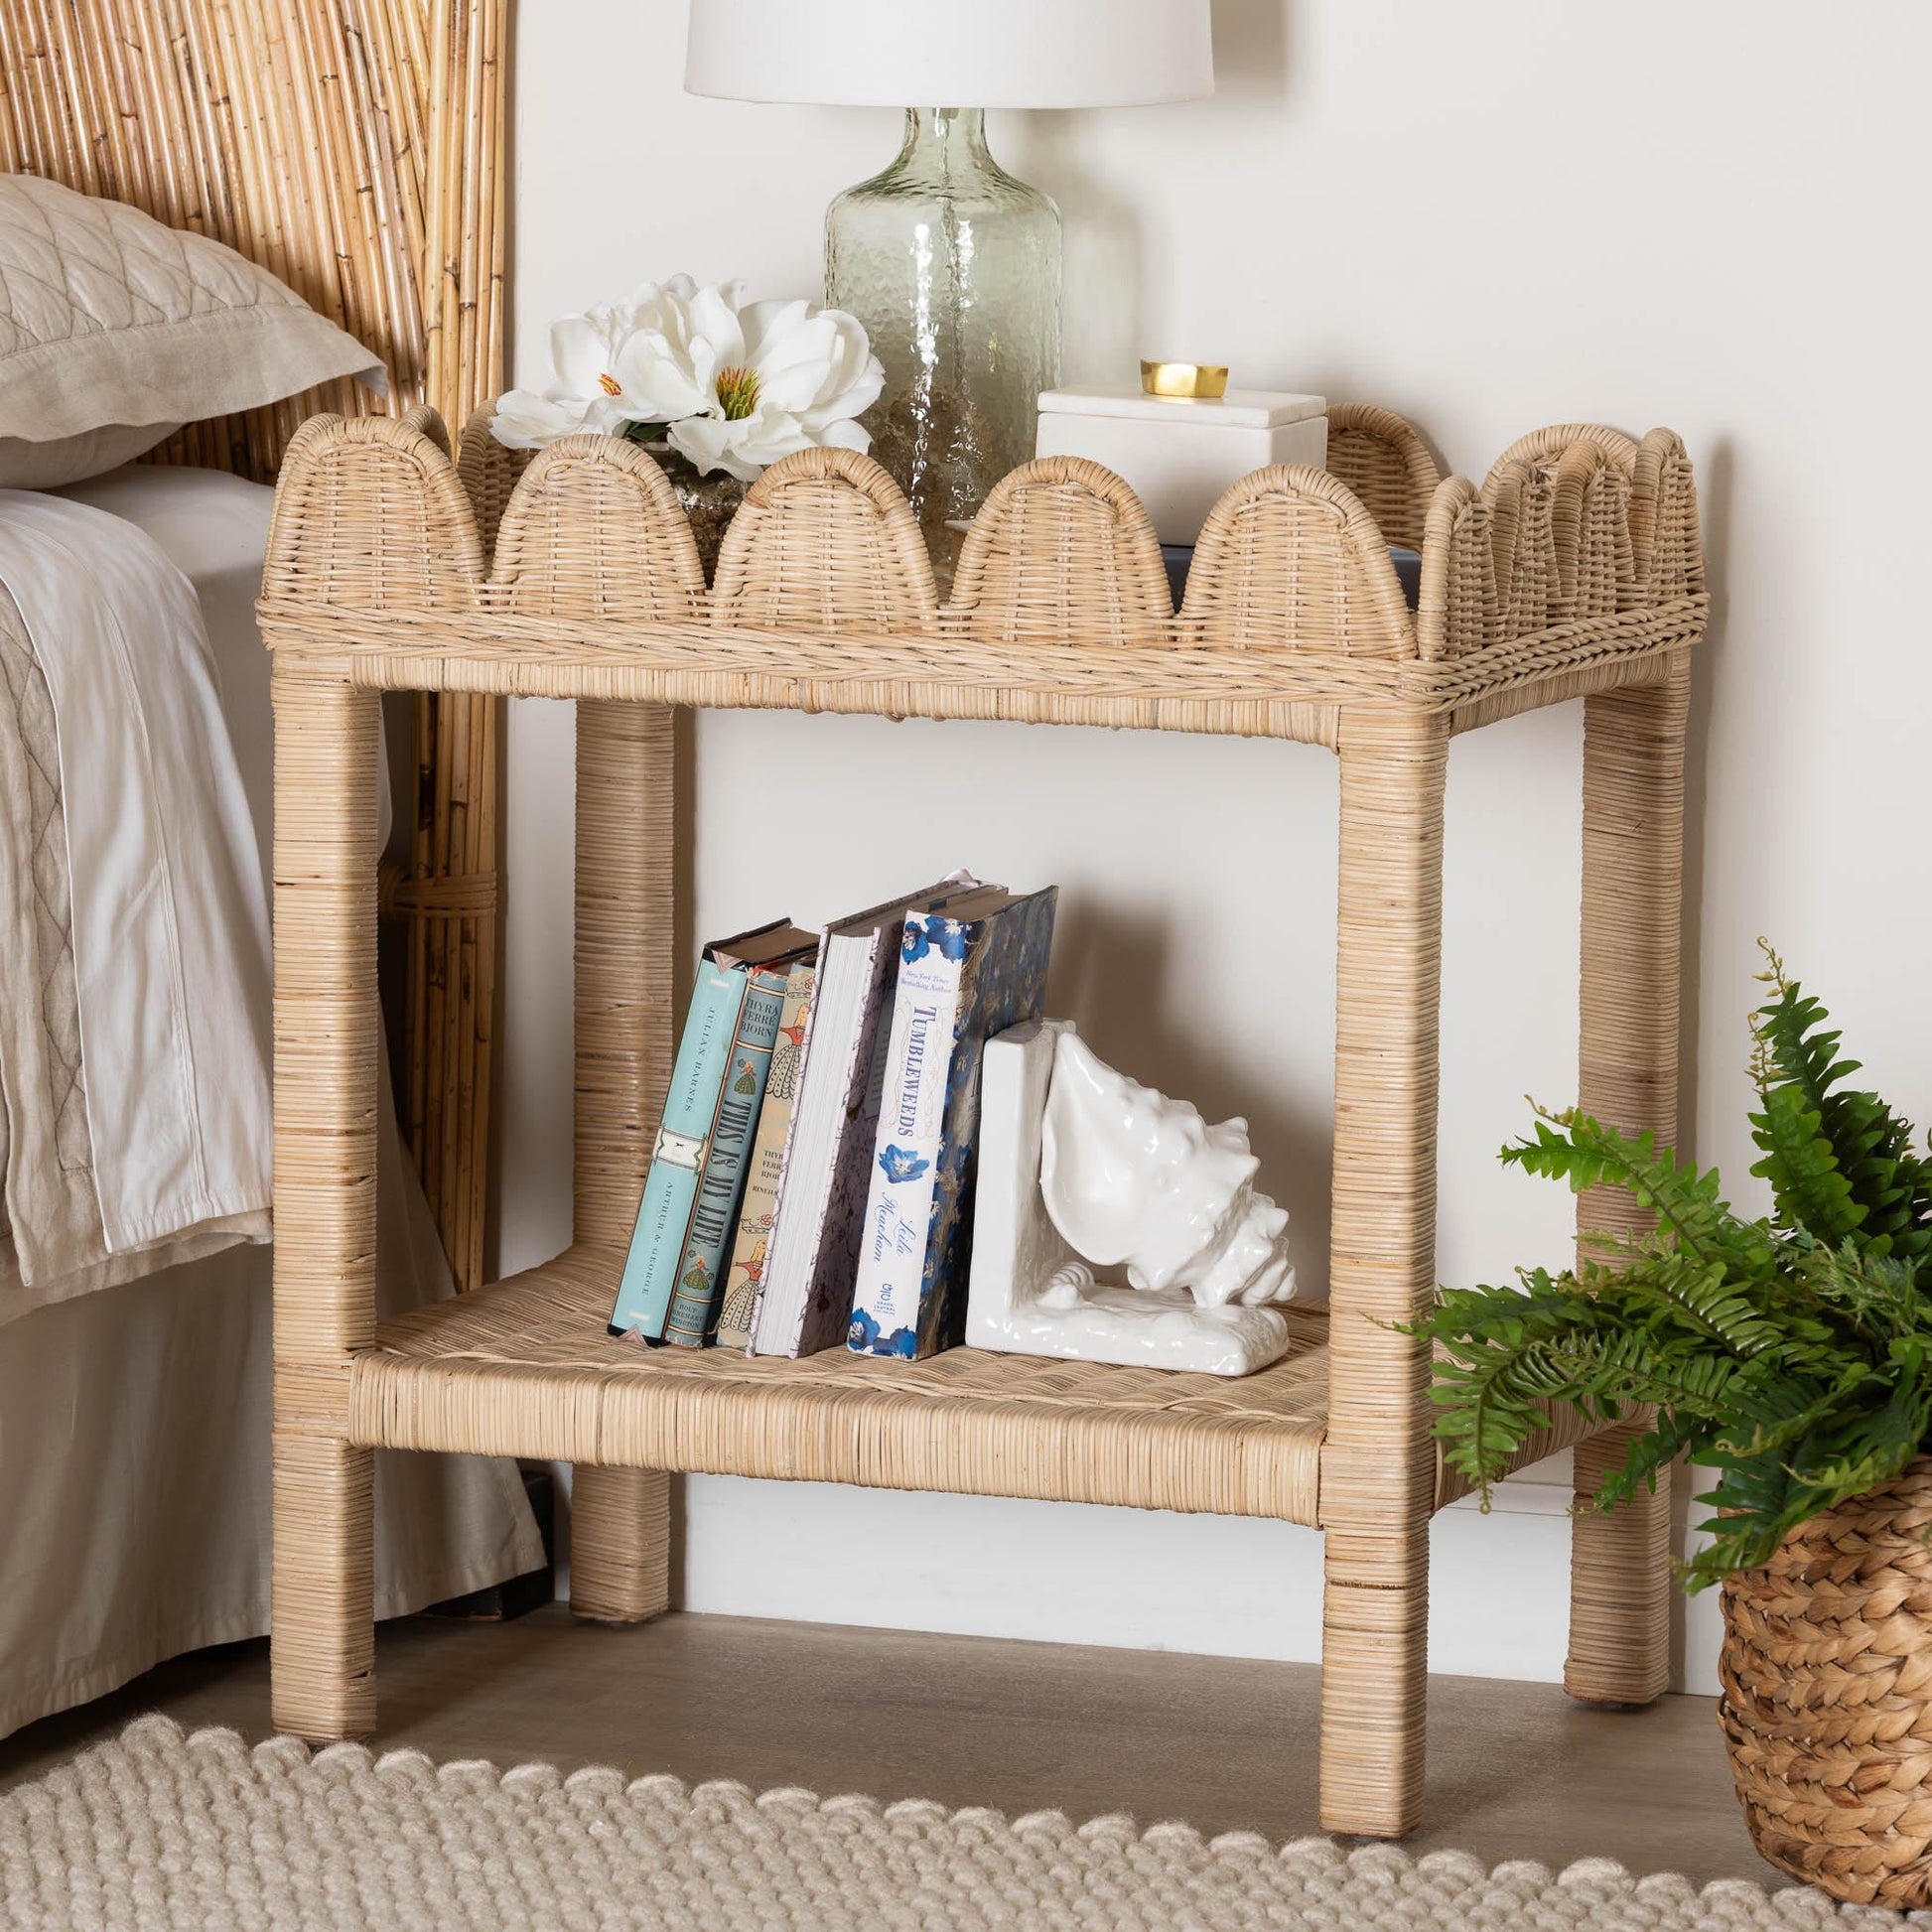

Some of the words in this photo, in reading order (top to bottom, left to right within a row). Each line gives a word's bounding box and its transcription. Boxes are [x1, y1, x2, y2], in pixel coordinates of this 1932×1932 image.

[698, 1007, 716, 1056] JULIAN
[684, 1061, 703, 1112] BARNES
[716, 1099, 753, 1145] THIS
[711, 1147, 741, 1170] IS
[657, 1181, 674, 1230] ARTHUR
[703, 1171, 735, 1203] MY
[654, 1234, 662, 1243] &
[691, 1204, 728, 1249] LIFE
[874, 1191, 898, 1263] Meacham
[894, 1216, 916, 1257] Leila
[642, 1248, 658, 1296] GEORGE
